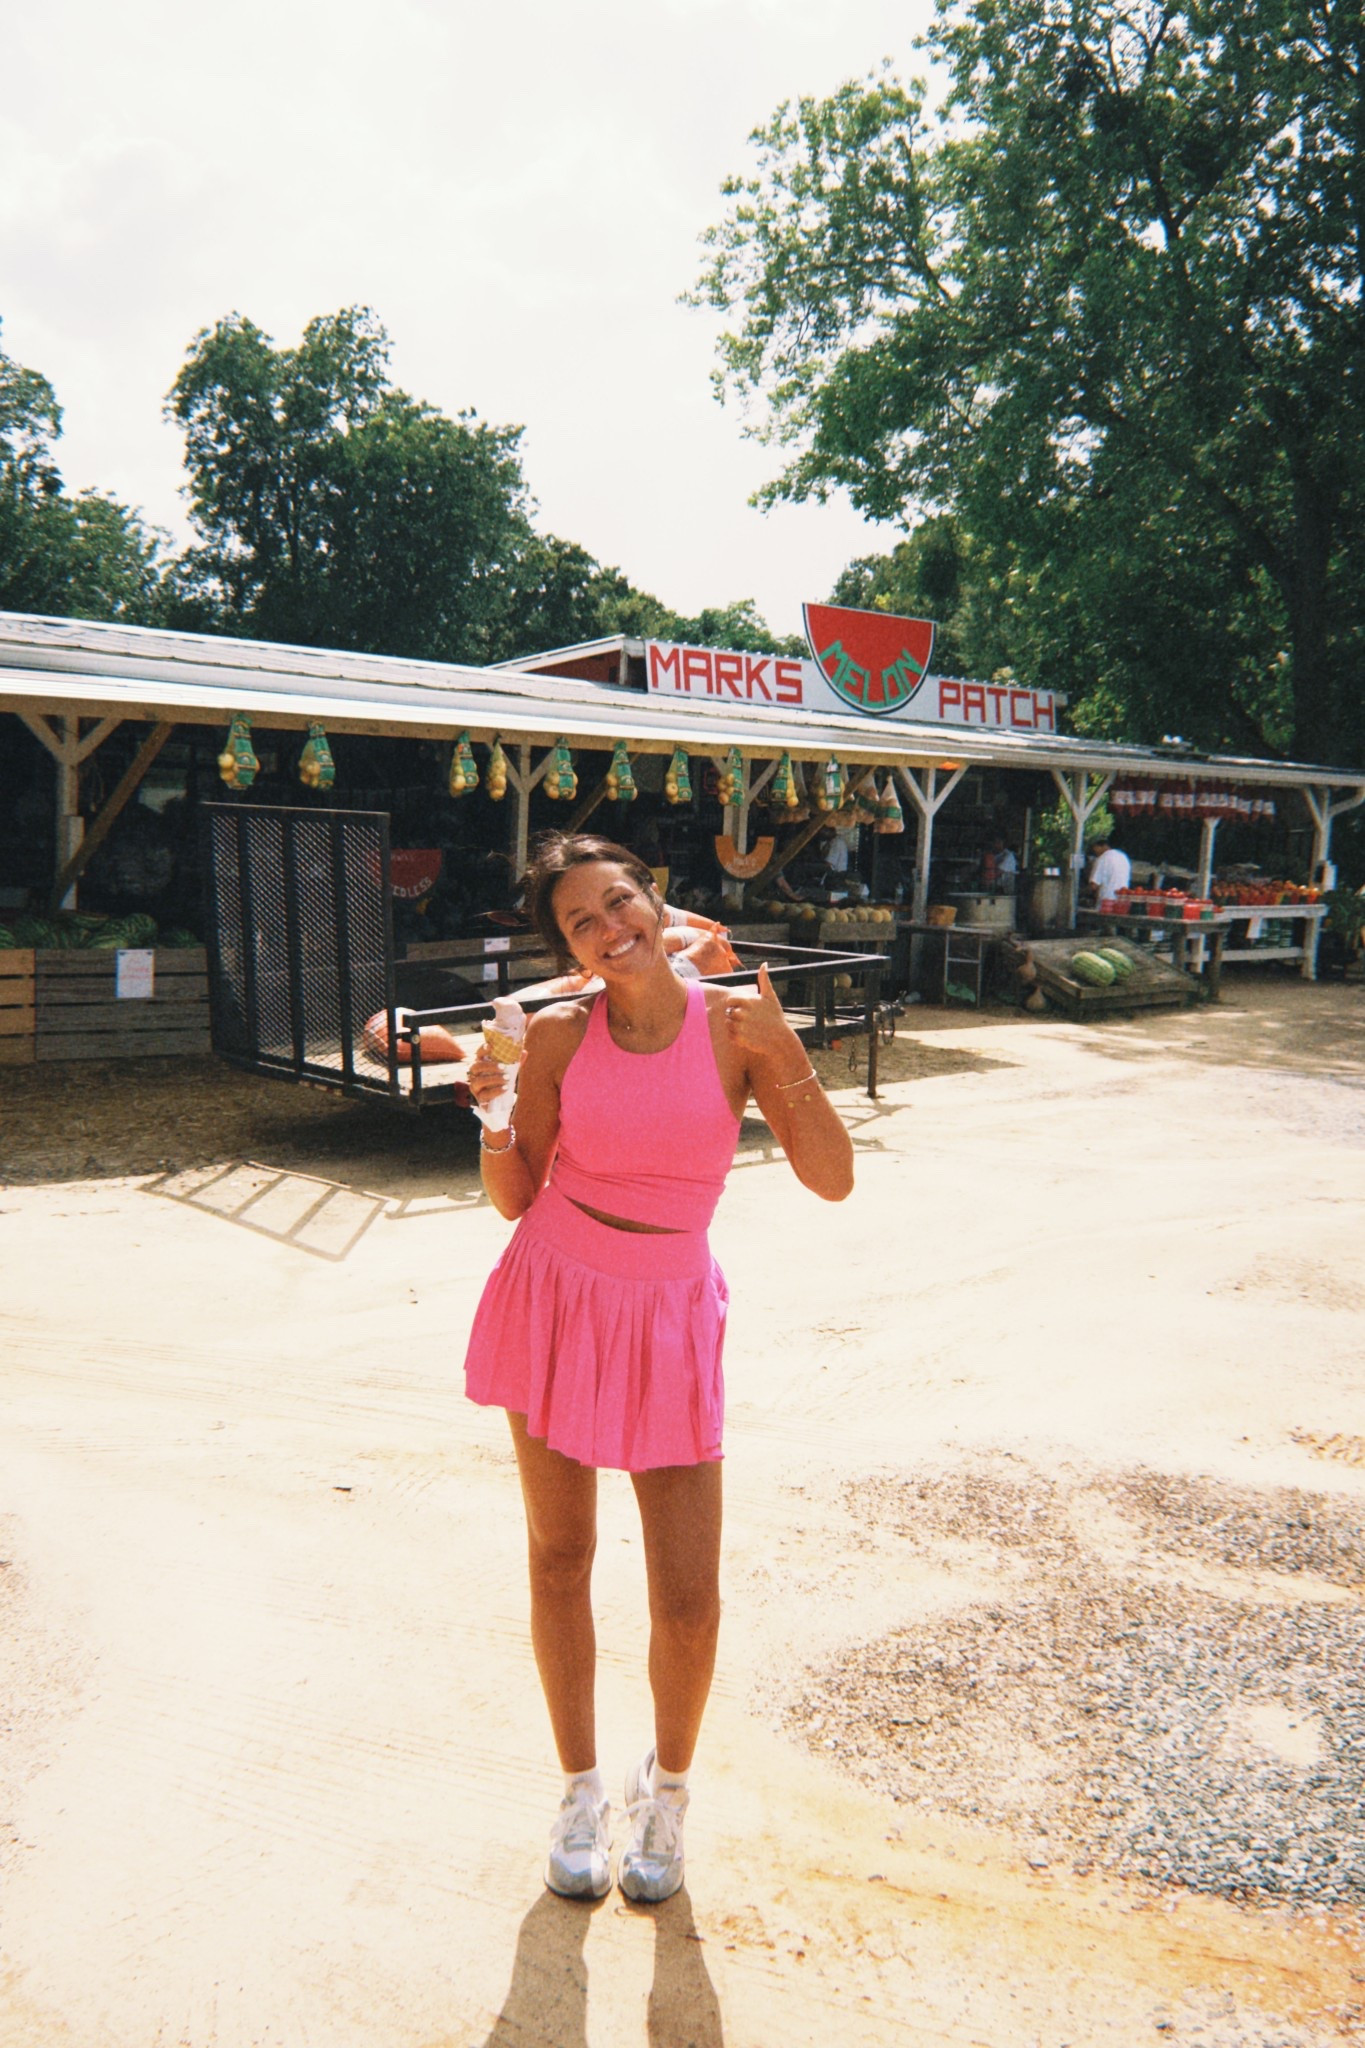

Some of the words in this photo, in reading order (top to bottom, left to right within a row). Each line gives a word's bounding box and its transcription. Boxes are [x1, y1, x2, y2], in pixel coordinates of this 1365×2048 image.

[650, 645, 802, 704] MARKS
[818, 639, 924, 709] MELON
[939, 680, 1054, 730] PATCH
[389, 876, 432, 898] EDLESS
